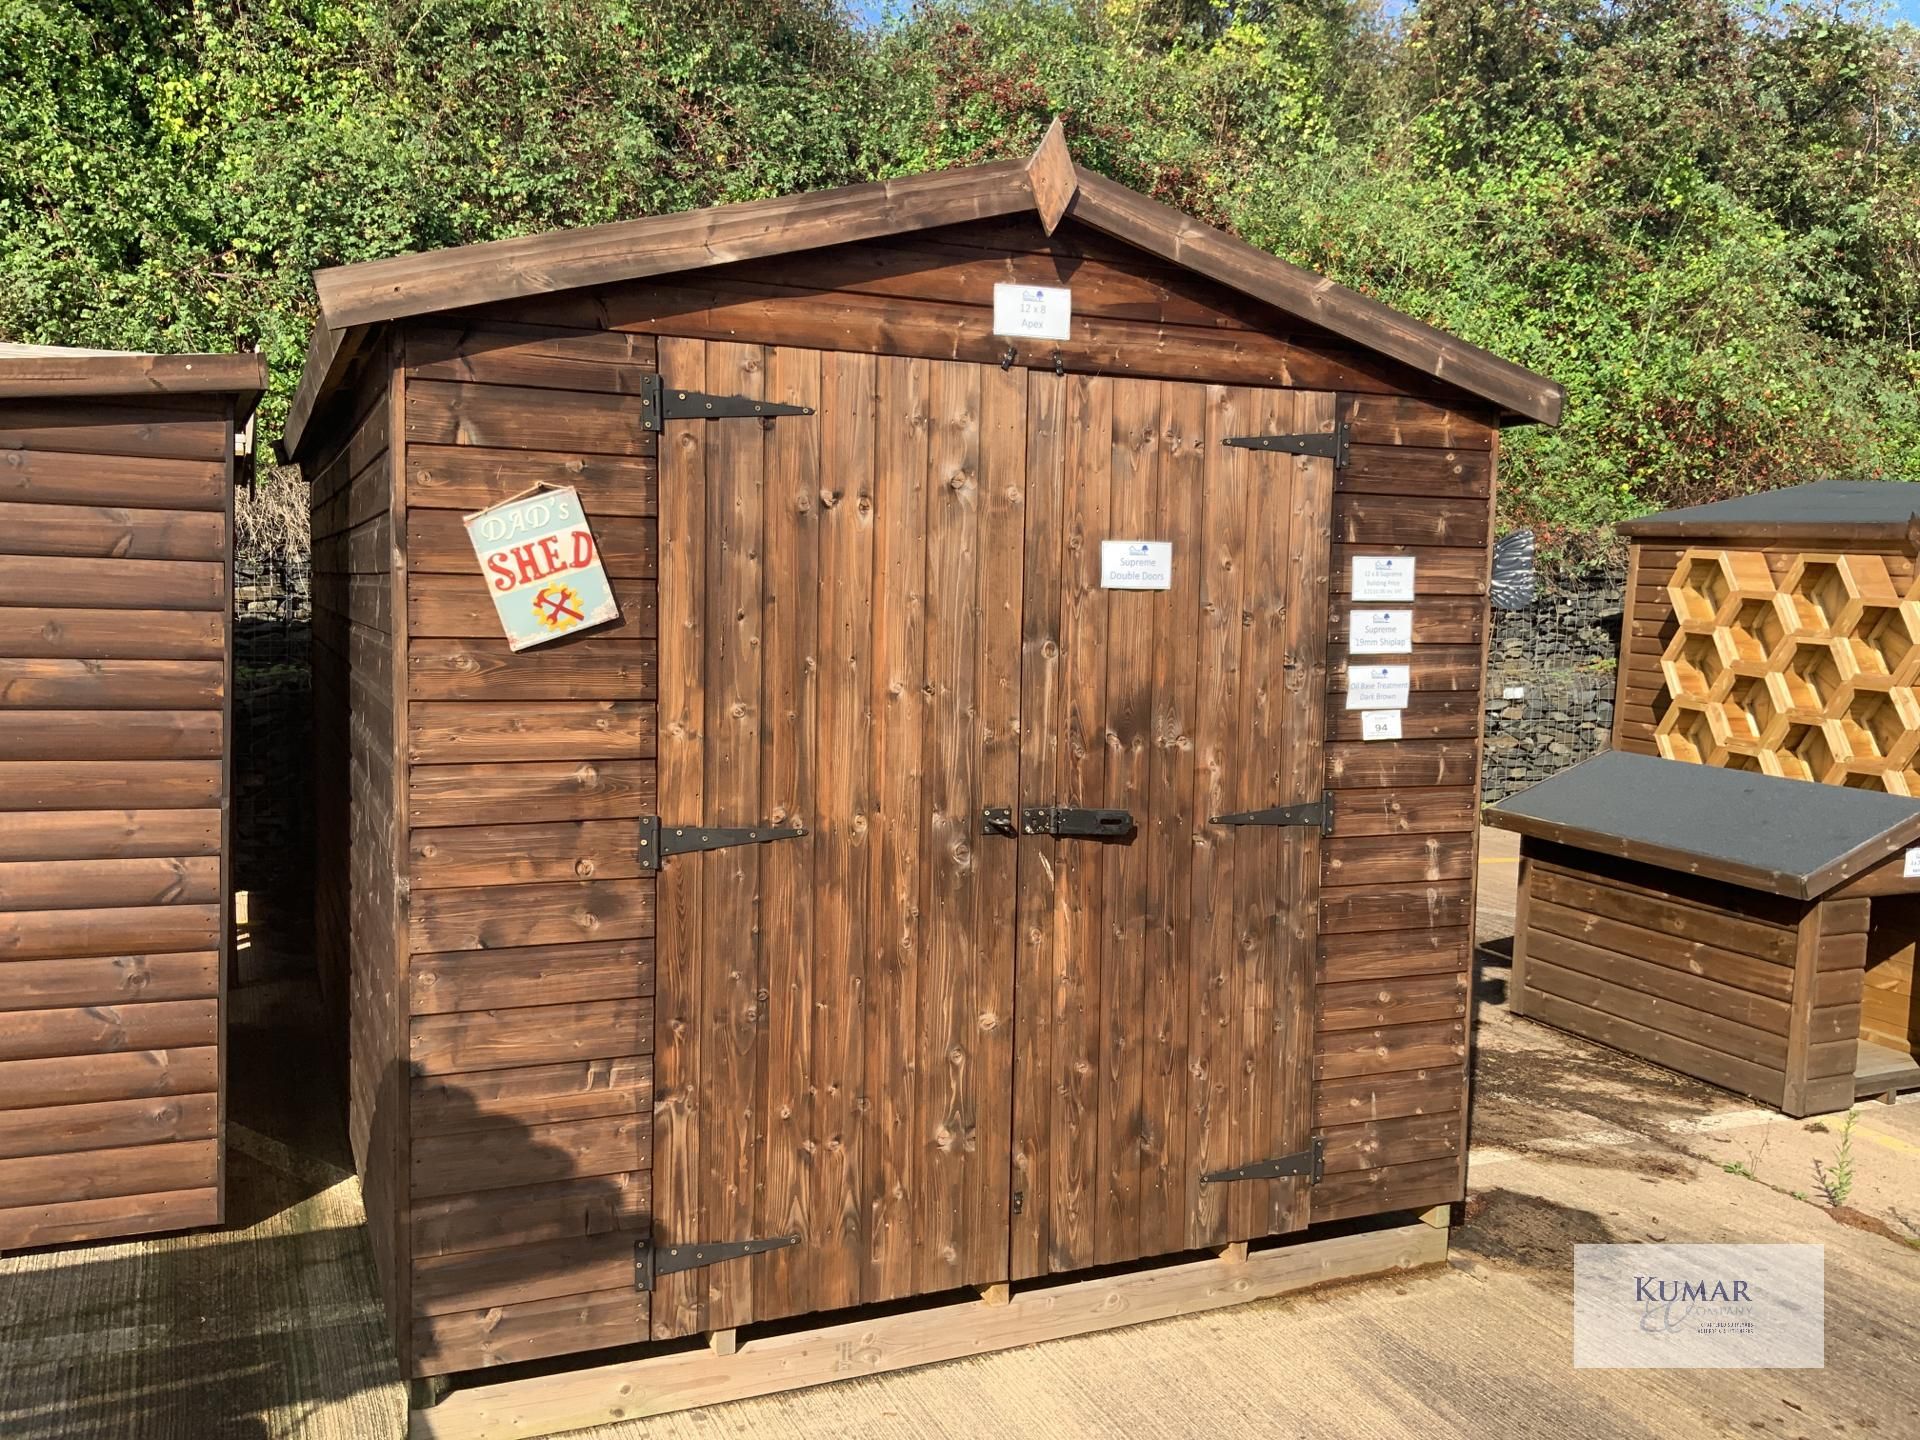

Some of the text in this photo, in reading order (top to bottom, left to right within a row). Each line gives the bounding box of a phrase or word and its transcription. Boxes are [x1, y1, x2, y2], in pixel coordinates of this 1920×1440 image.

[1020, 303, 1031, 313] 12
[1040, 305, 1047, 314] 8
[1021, 318, 1043, 329] Apex
[487, 531, 593, 591] SHED
[1120, 557, 1156, 568] Supreme
[1110, 571, 1164, 580] Double Doors
[1364, 625, 1397, 634] Supreme
[1355, 638, 1406, 647] 19mm Shiplap
[1376, 681, 1408, 689] Treatment
[1360, 692, 1397, 701] Dark Brown
[1375, 723, 1388, 732] 94
